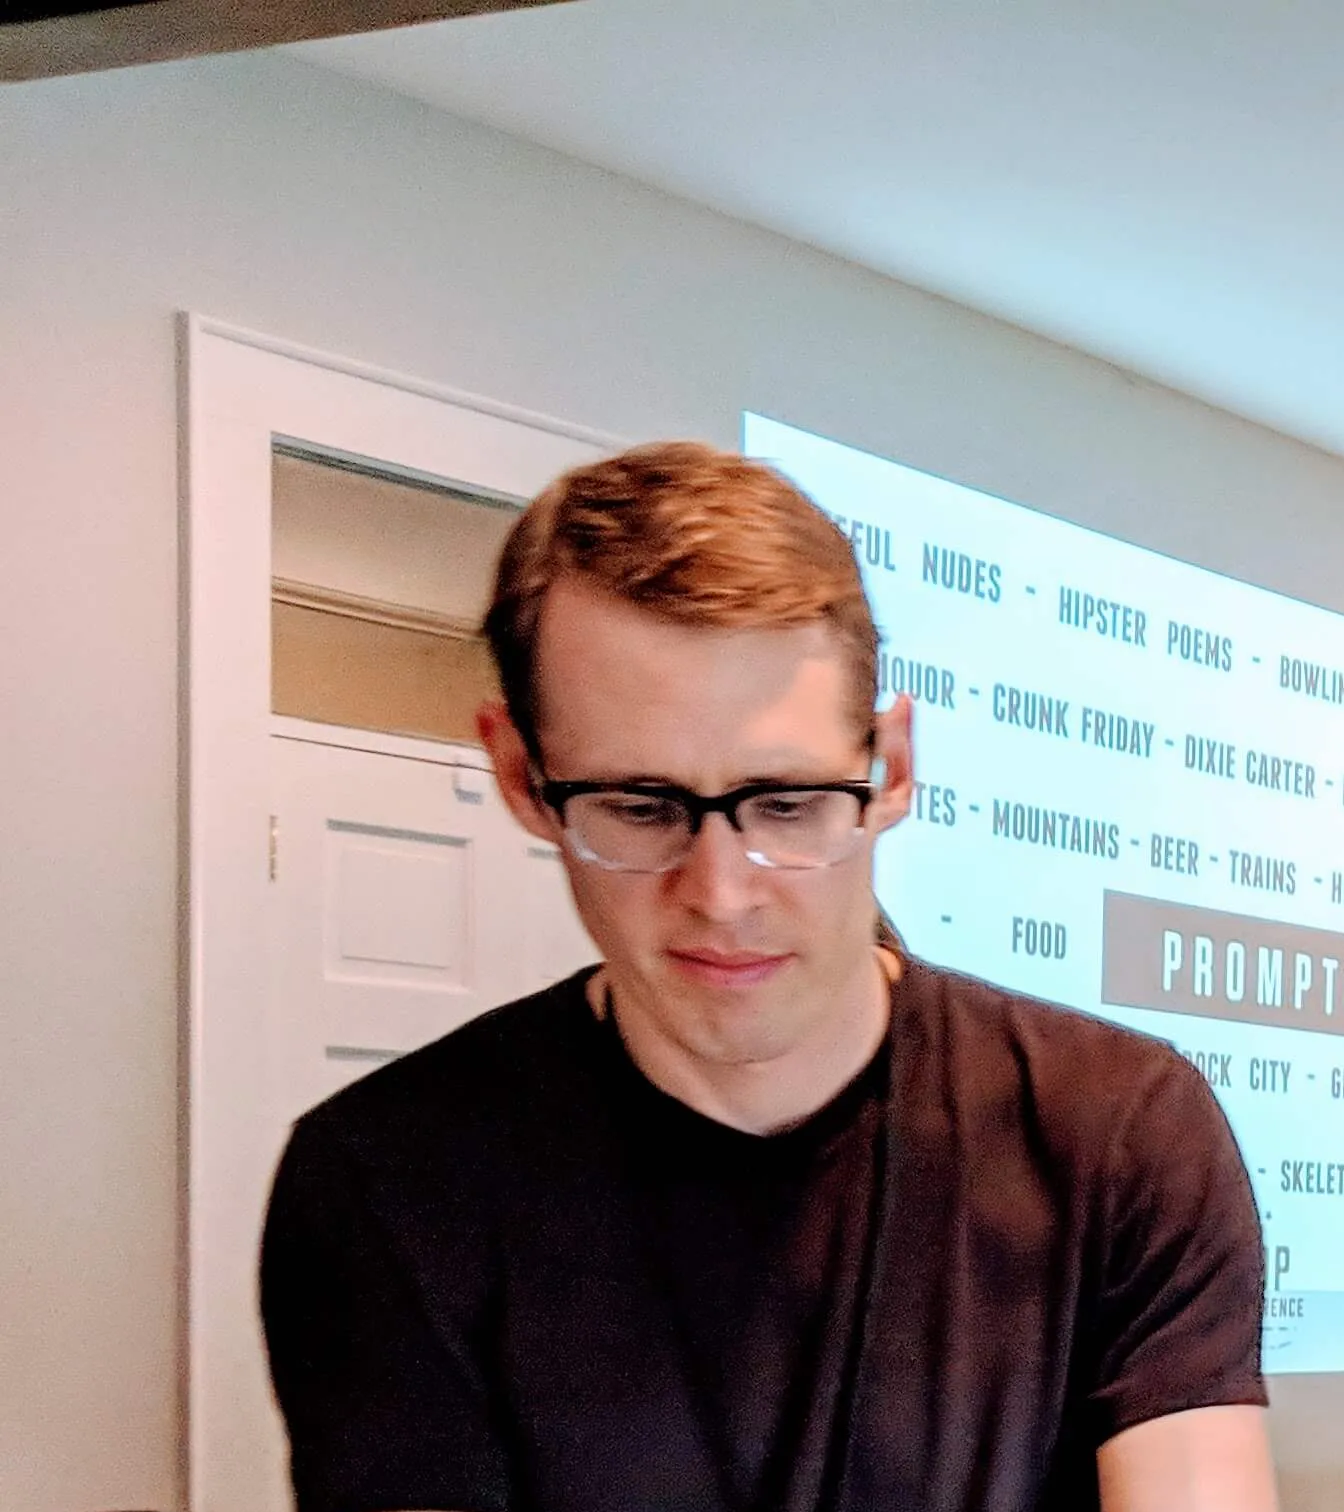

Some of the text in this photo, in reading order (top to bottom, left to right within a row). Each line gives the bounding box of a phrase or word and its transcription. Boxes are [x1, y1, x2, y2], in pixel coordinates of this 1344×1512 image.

[836, 514, 896, 571] FUL
[922, 542, 1001, 602] NUDES
[1059, 585, 1147, 647] HIPSTER
[1167, 620, 1232, 672] POEMS
[880, 652, 955, 710] IQUOR
[993, 683, 1069, 738] CRUNK
[1082, 707, 1155, 759] FRIDAY
[1184, 733, 1236, 779] DIXIE
[1247, 750, 1315, 798] CARTER
[915, 781, 956, 826] TES
[992, 798, 1119, 860] MOUNTAINS
[1150, 834, 1199, 876] BEER
[1229, 850, 1296, 895] TRAINS
[1012, 916, 1066, 960] FOOD
[1249, 1057, 1291, 1093] CITY
